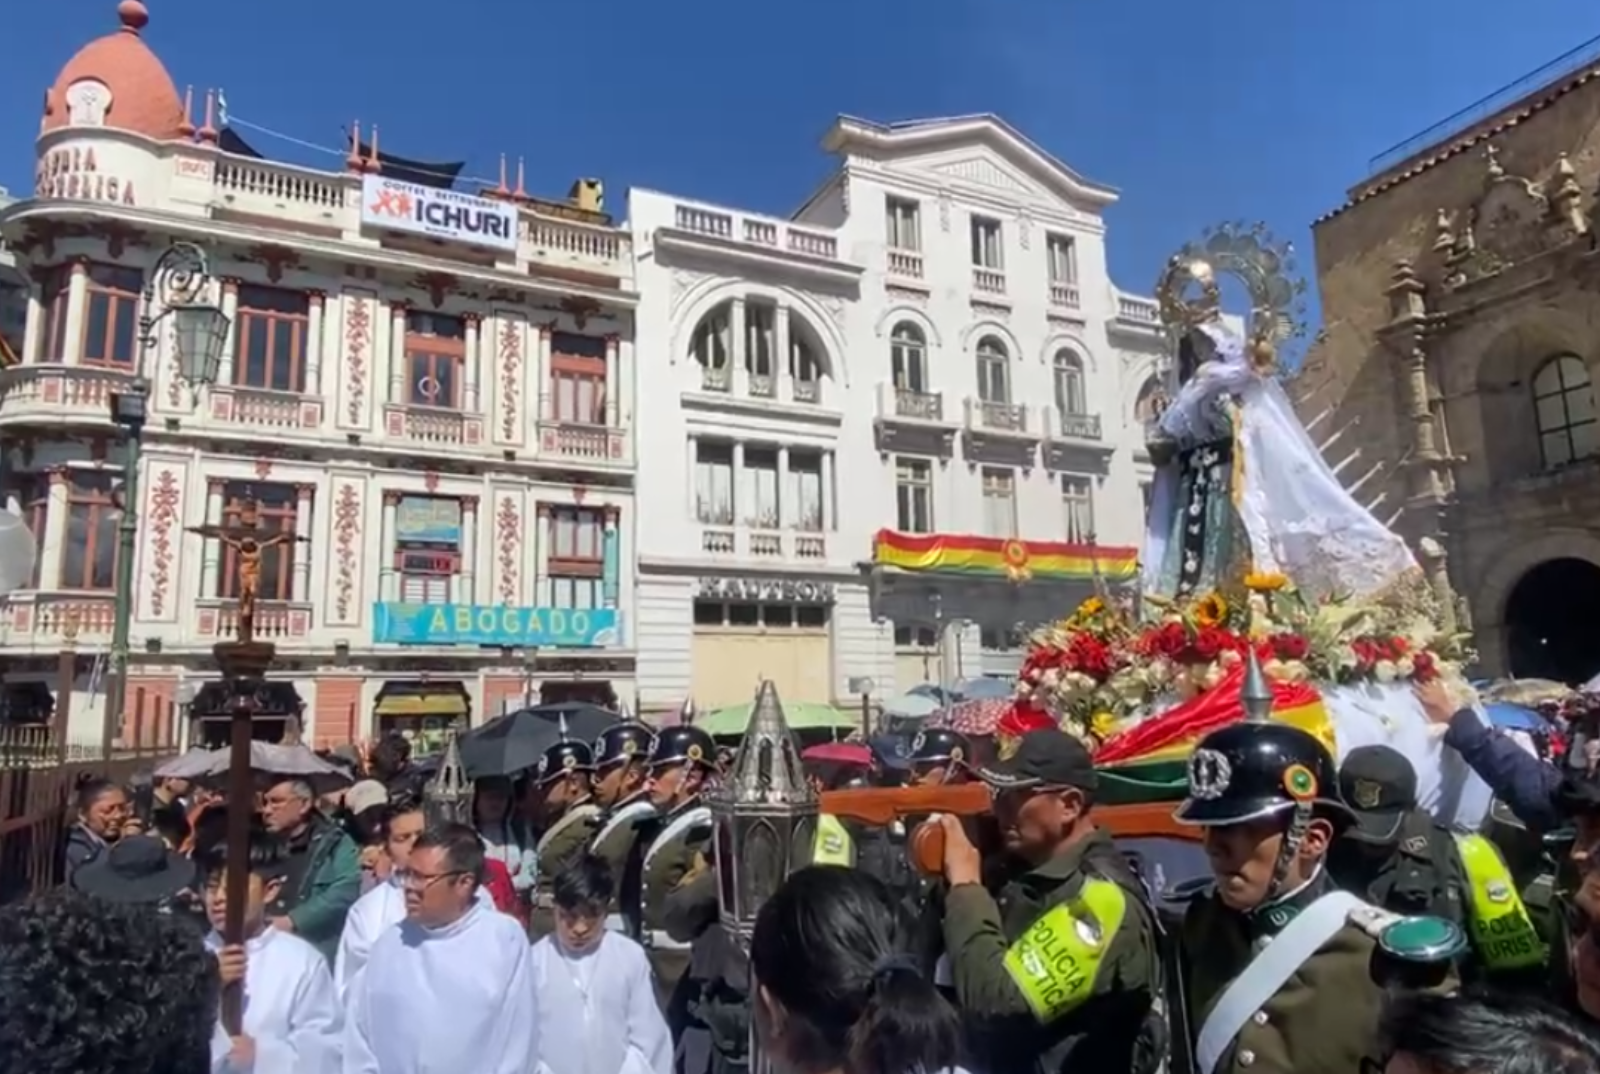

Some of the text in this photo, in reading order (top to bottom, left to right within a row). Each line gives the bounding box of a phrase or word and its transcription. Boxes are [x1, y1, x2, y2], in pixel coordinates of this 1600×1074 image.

[416, 199, 510, 239] ICHURI
[429, 608, 590, 635] ABOGADO
[1032, 919, 1087, 994] POLICIA
